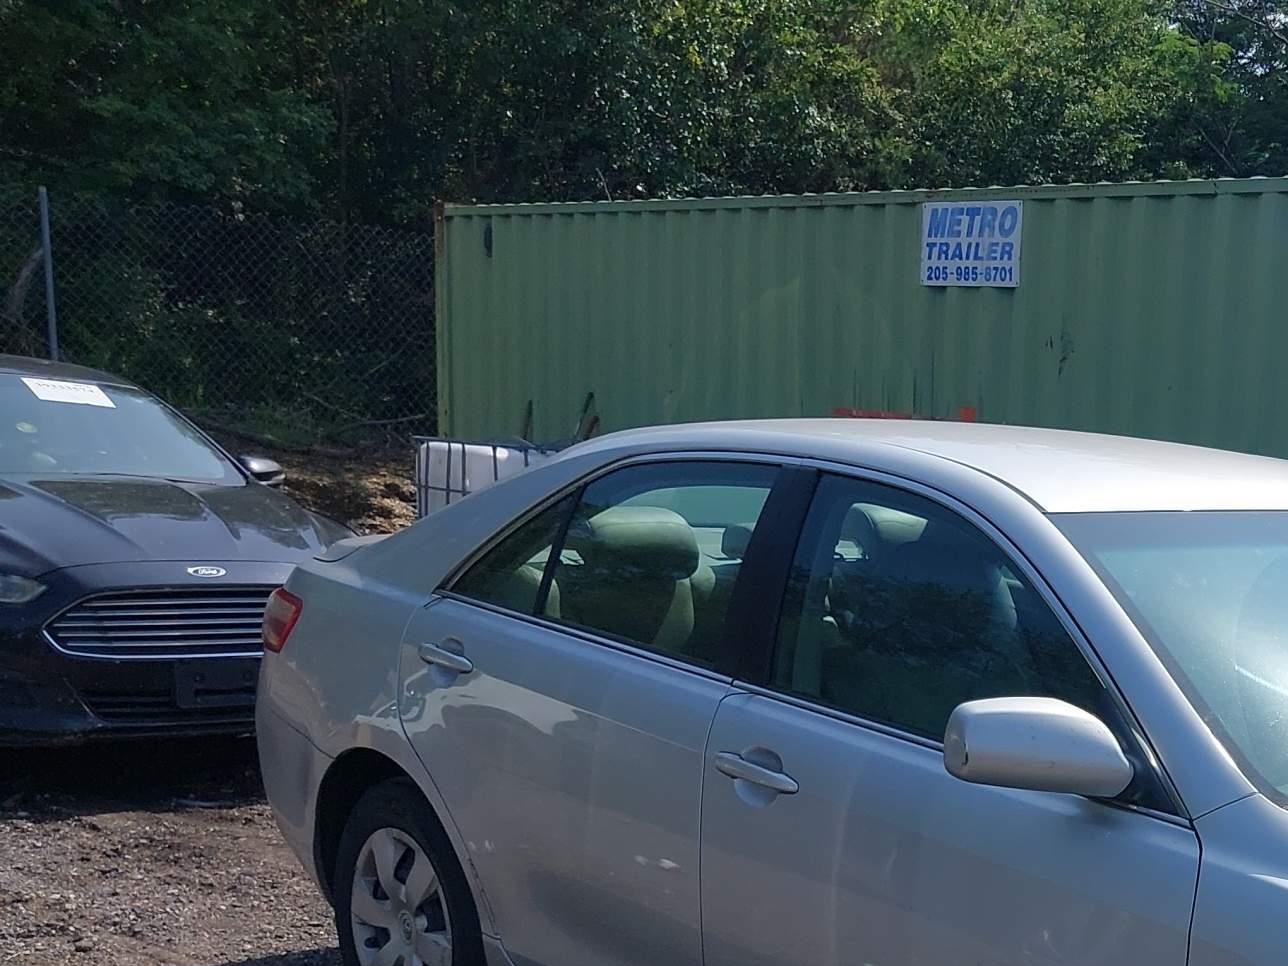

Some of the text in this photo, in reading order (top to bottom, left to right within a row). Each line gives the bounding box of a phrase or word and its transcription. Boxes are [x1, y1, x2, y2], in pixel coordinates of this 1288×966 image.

[927, 206, 1018, 238] METRO
[926, 242, 1014, 261] TRAILER
[926, 266, 1013, 282] 205-985-8701
